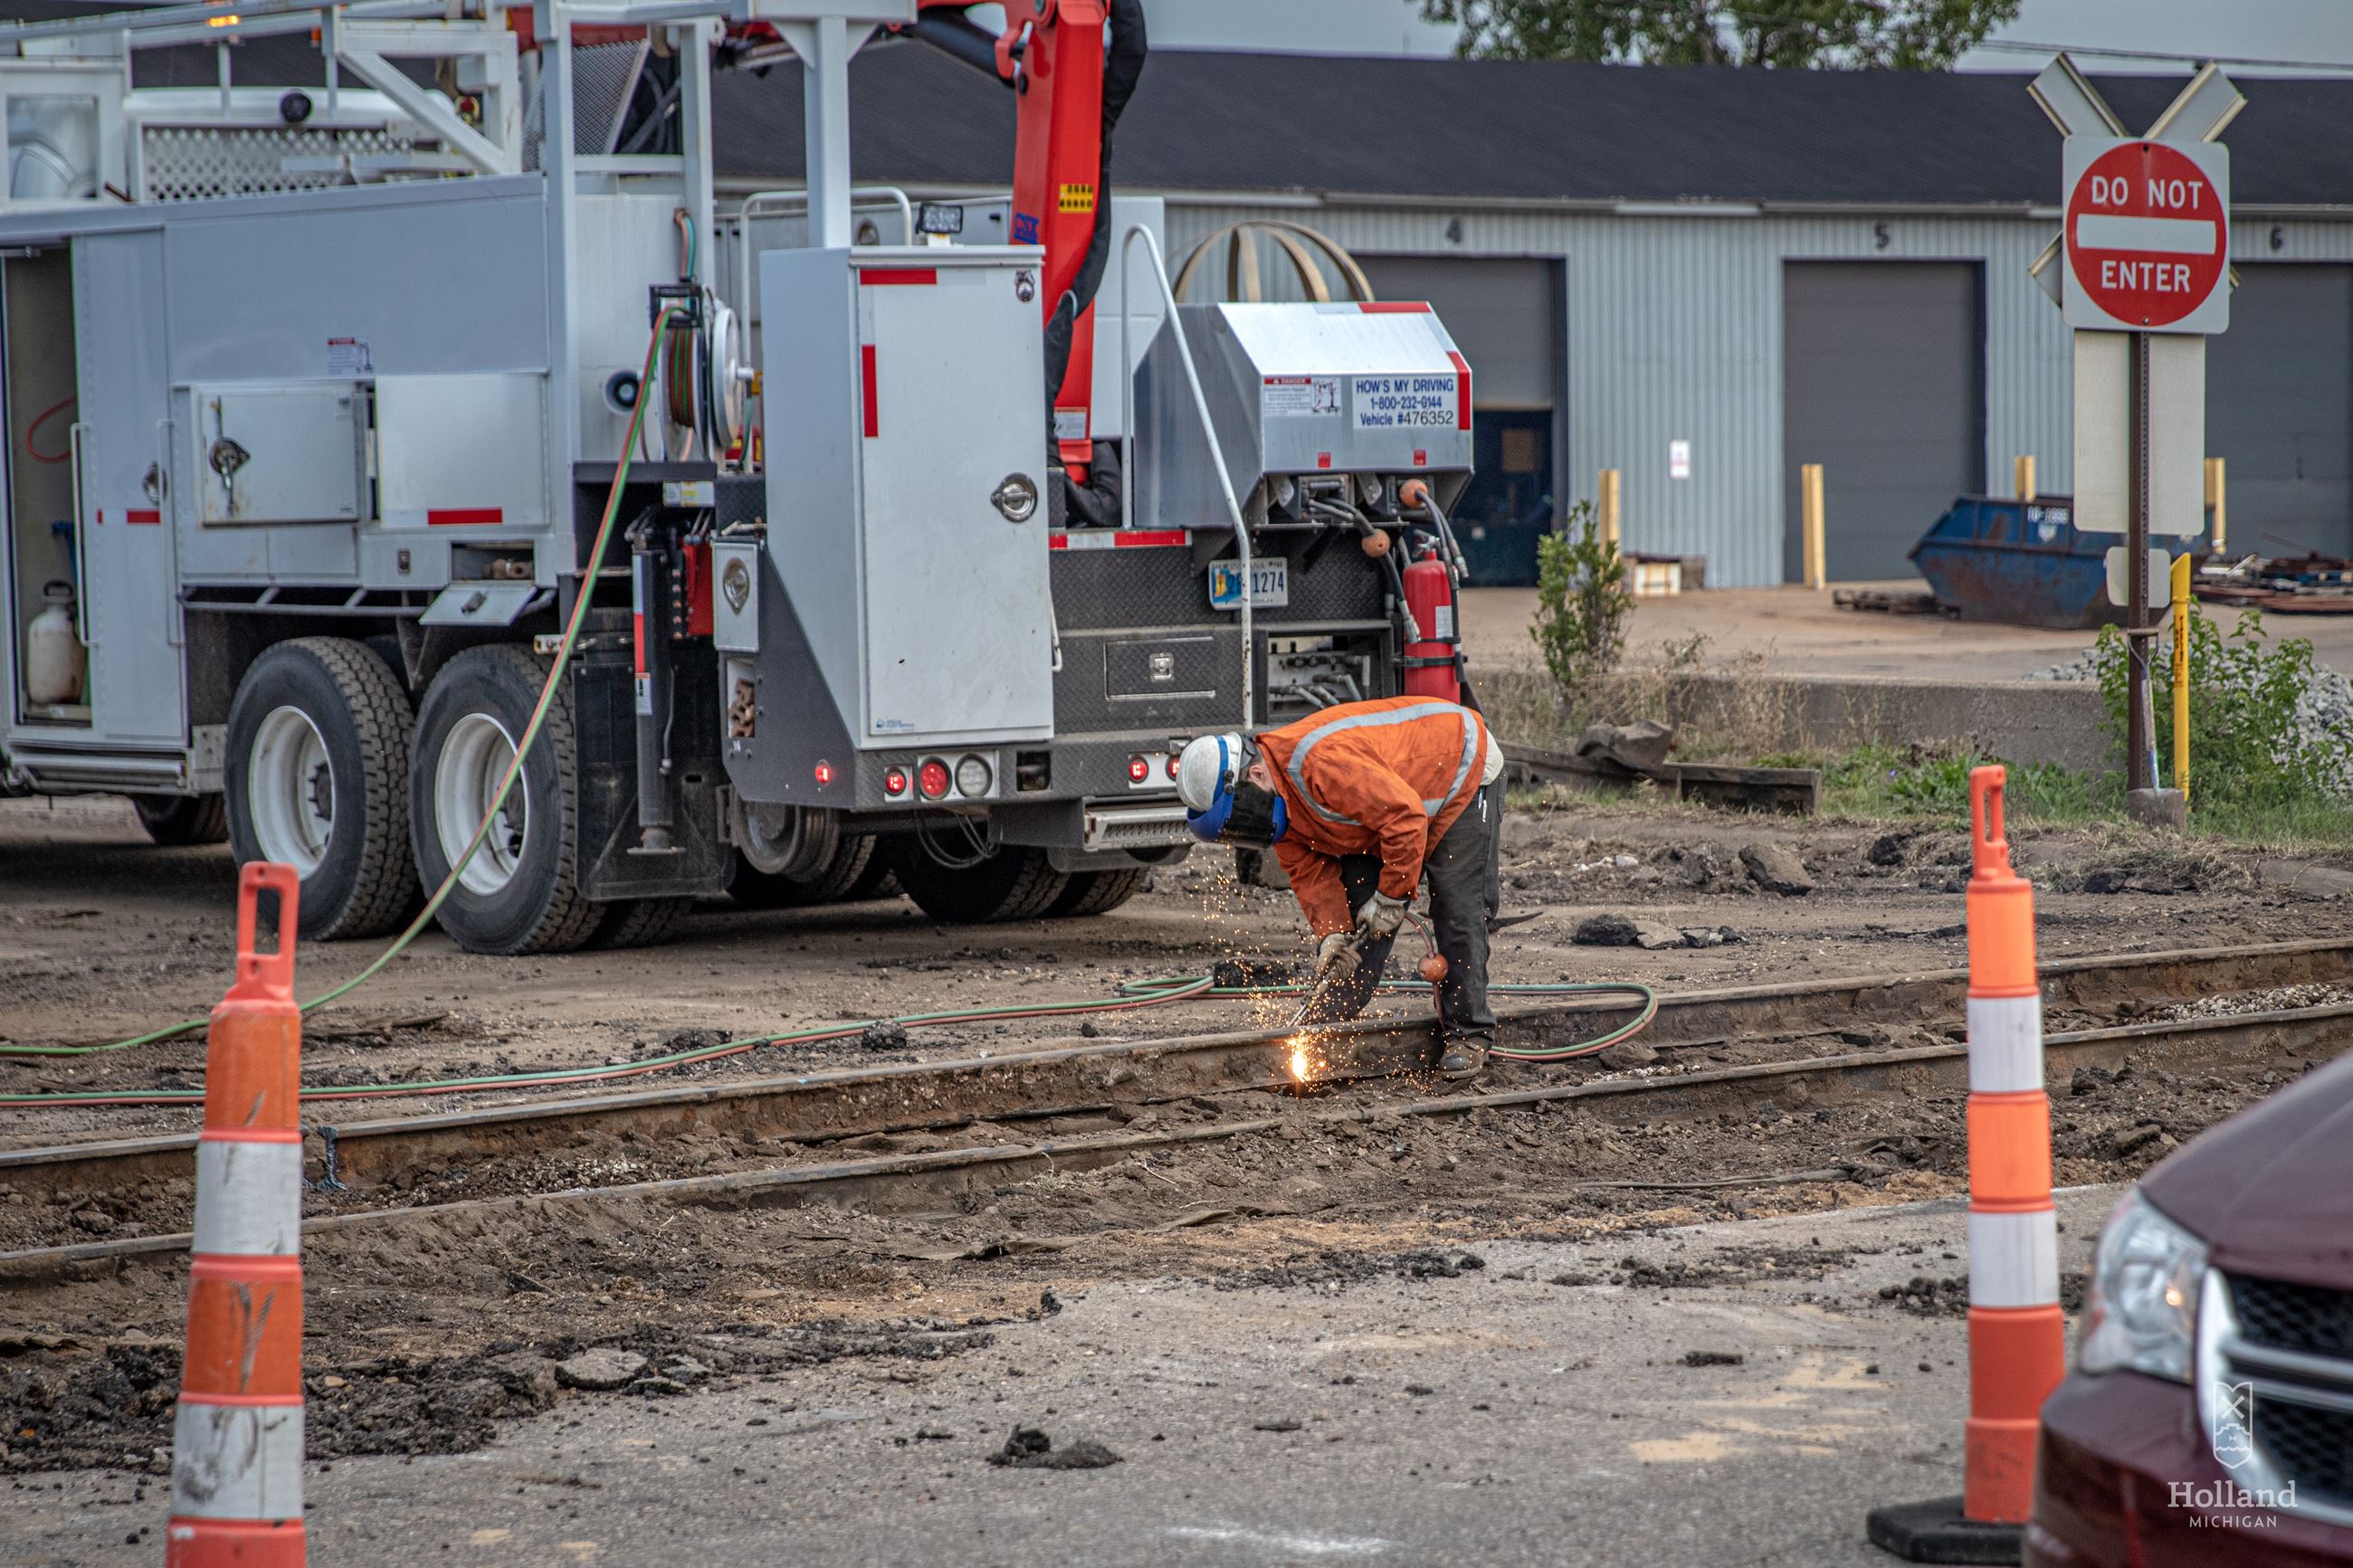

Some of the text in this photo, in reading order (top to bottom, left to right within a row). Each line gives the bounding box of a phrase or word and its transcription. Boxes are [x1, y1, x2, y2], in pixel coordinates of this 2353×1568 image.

[2091, 176, 2204, 210] DO NOT
[1445, 218, 1462, 243] 4
[1875, 222, 1890, 250] 5
[2101, 260, 2191, 293] ENTER
[1356, 378, 1453, 394] HOW'S MY DRIVING
[1370, 396, 1442, 410] 1-800-232-0144
[1360, 410, 1453, 425] Vehicle #476352
